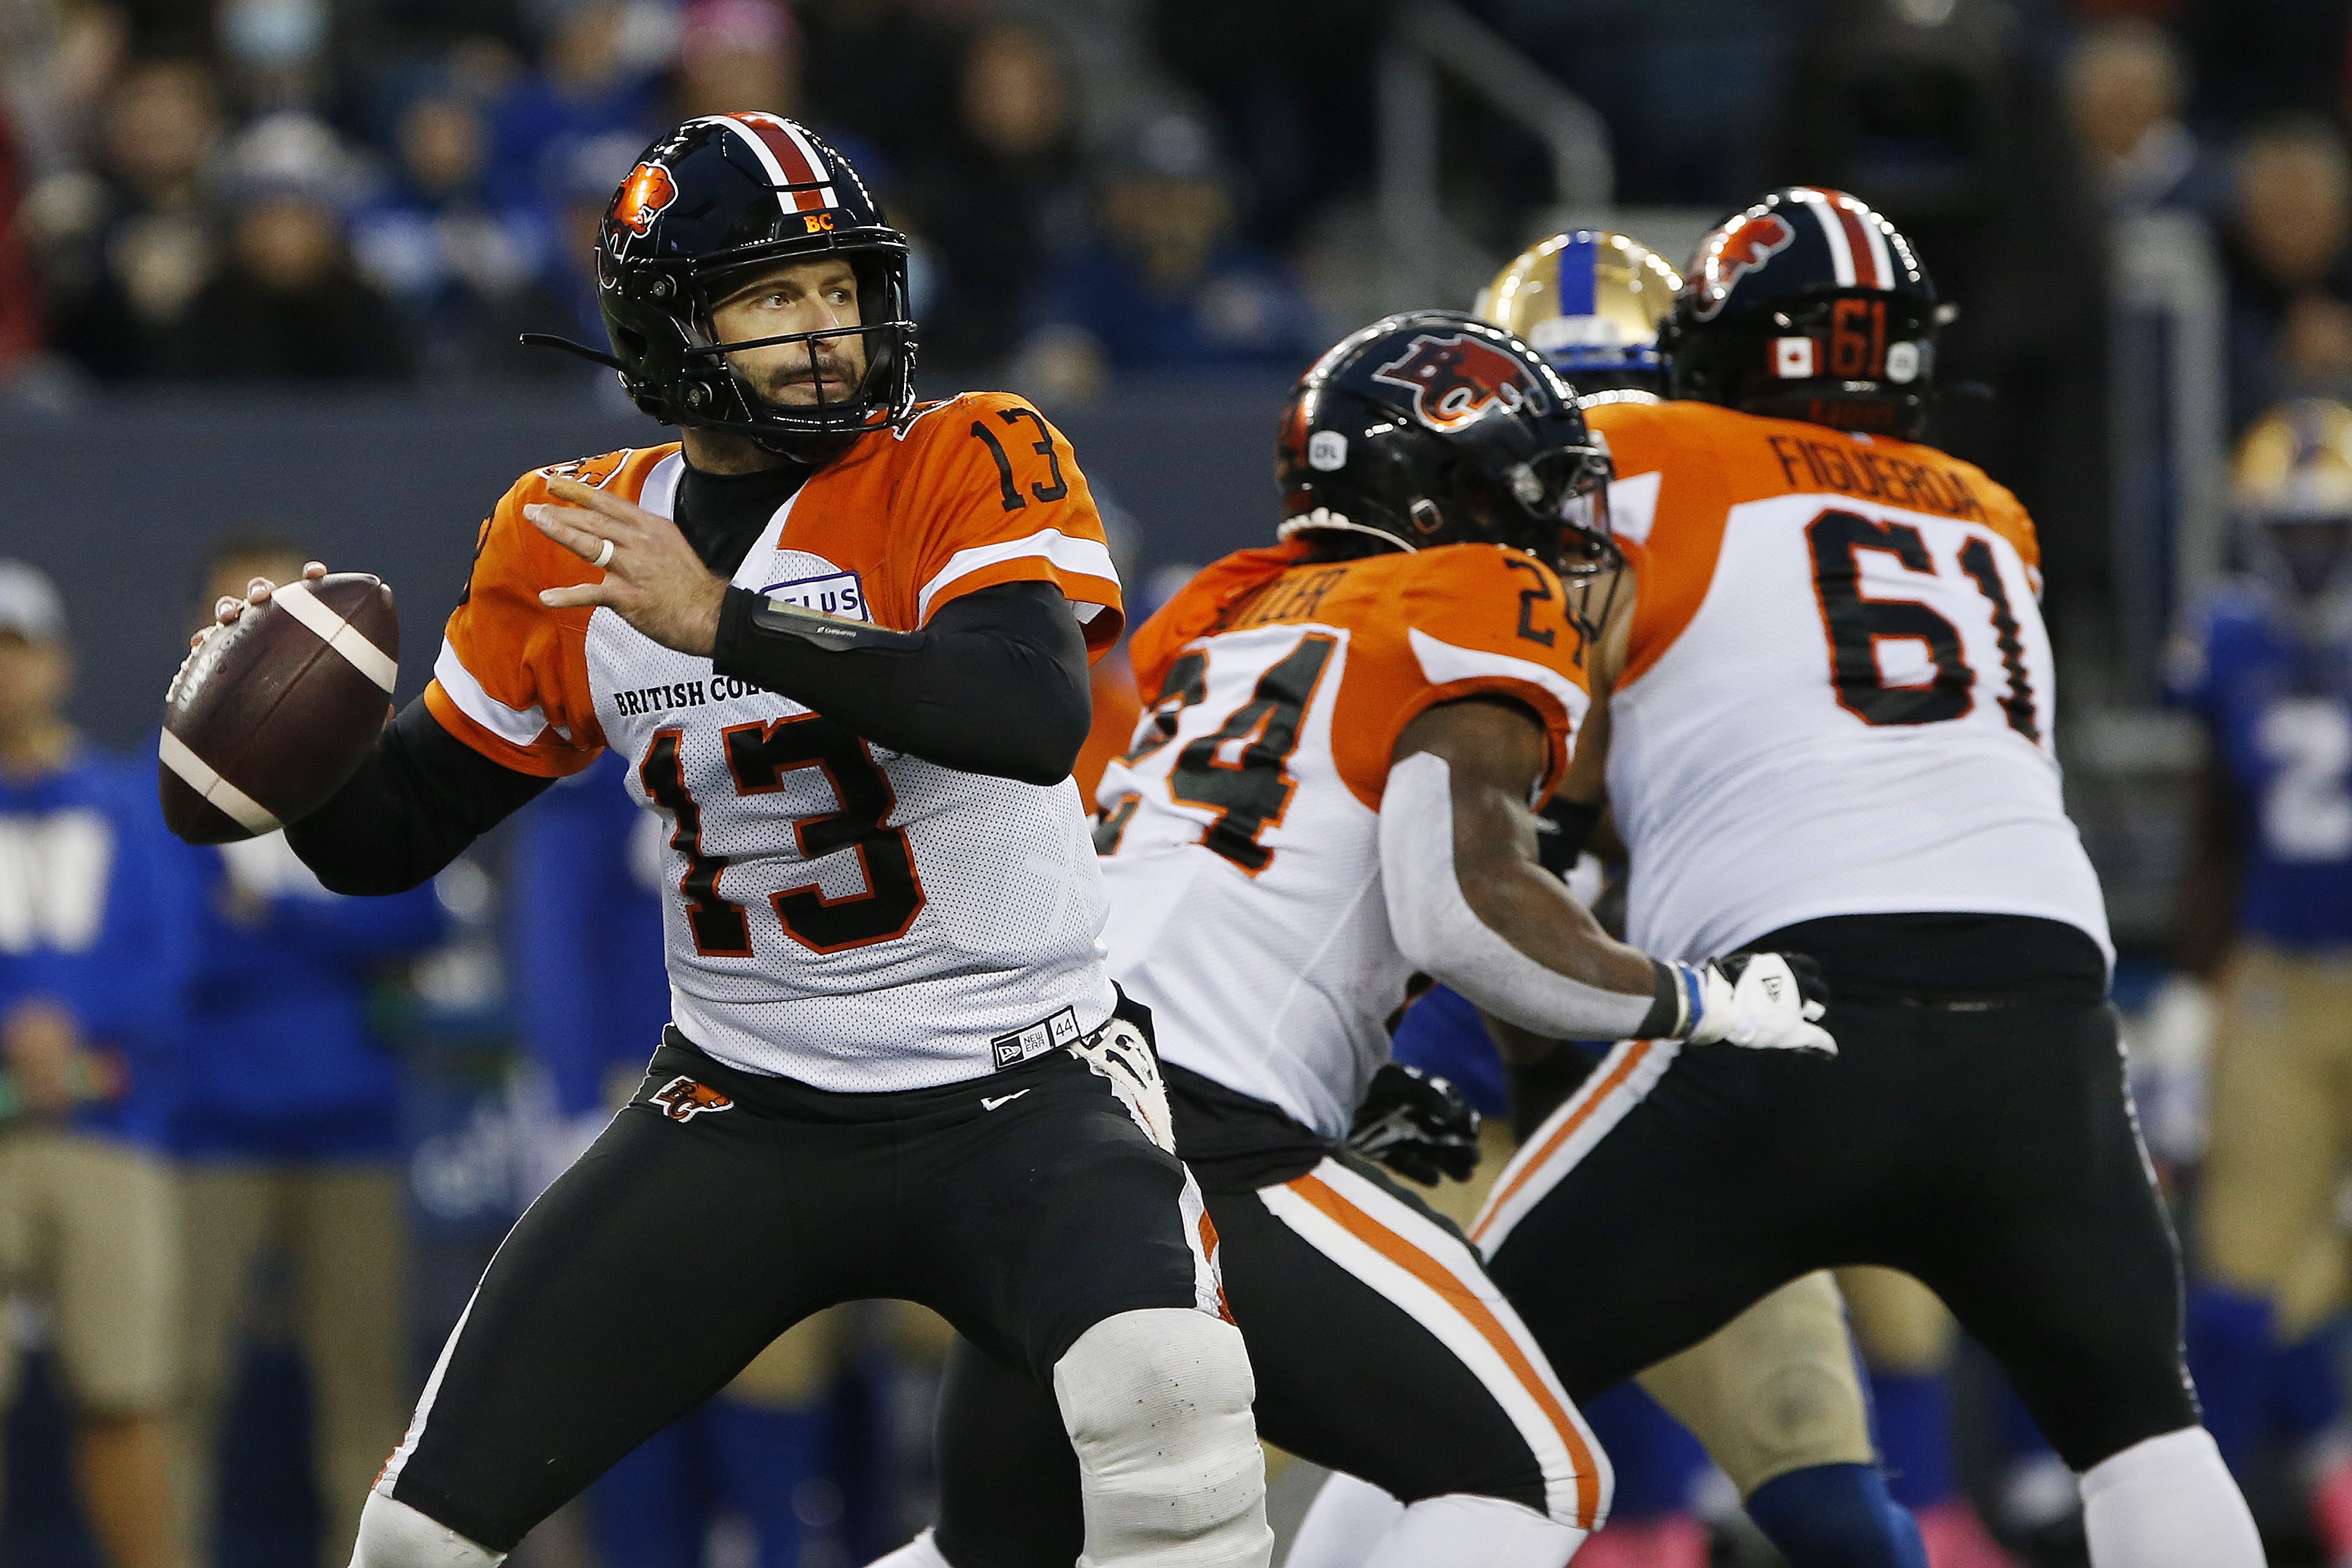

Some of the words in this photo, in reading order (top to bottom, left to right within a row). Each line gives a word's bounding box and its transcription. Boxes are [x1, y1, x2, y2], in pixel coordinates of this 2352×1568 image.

[803, 213, 834, 233] BC
[1832, 299, 1886, 378] 61
[970, 407, 1069, 513] 13
[1768, 434, 1990, 523] FIGUEROA
[1804, 508, 2042, 748] 61
[614, 680, 706, 717] BRITISH
[639, 710, 927, 958] 13
[1023, 1031, 1043, 1045] NEW
[1026, 1038, 1045, 1052] ERA
[1056, 1018, 1073, 1037] 44
